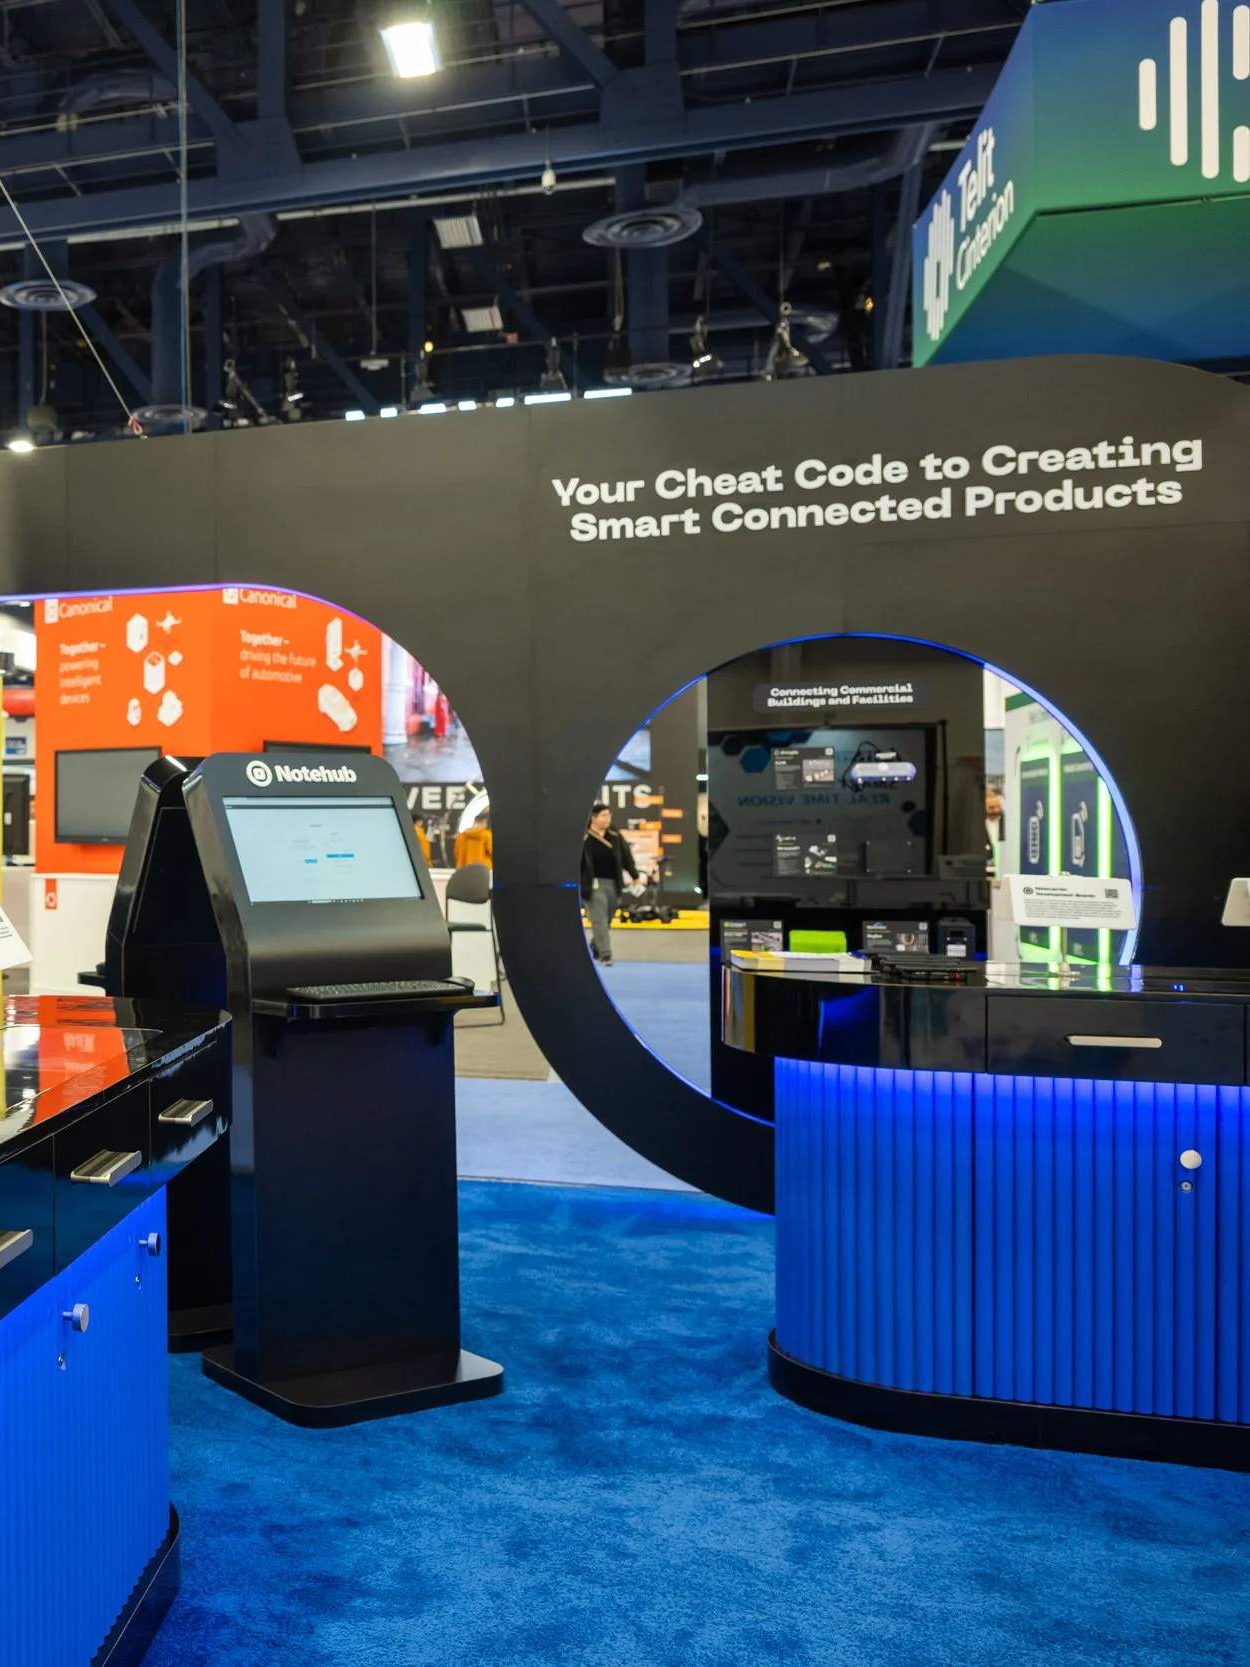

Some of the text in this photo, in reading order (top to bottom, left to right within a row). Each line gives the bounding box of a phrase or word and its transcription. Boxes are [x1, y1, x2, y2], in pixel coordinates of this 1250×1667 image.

[957, 126, 996, 233] Telit
[955, 179, 1015, 291] Cinterion
[551, 435, 1203, 507] Your Cheat Code to Creating
[569, 477, 1184, 542] Smart Connected Products
[58, 596, 114, 619] Canonical
[239, 588, 297, 609] Canonical
[272, 651, 288, 665] the
[251, 669, 303, 684] automotive
[767, 694, 914, 708] Buildings and Facilities
[769, 683, 914, 698] Connecting Commercial
[273, 764, 358, 783] Notehub
